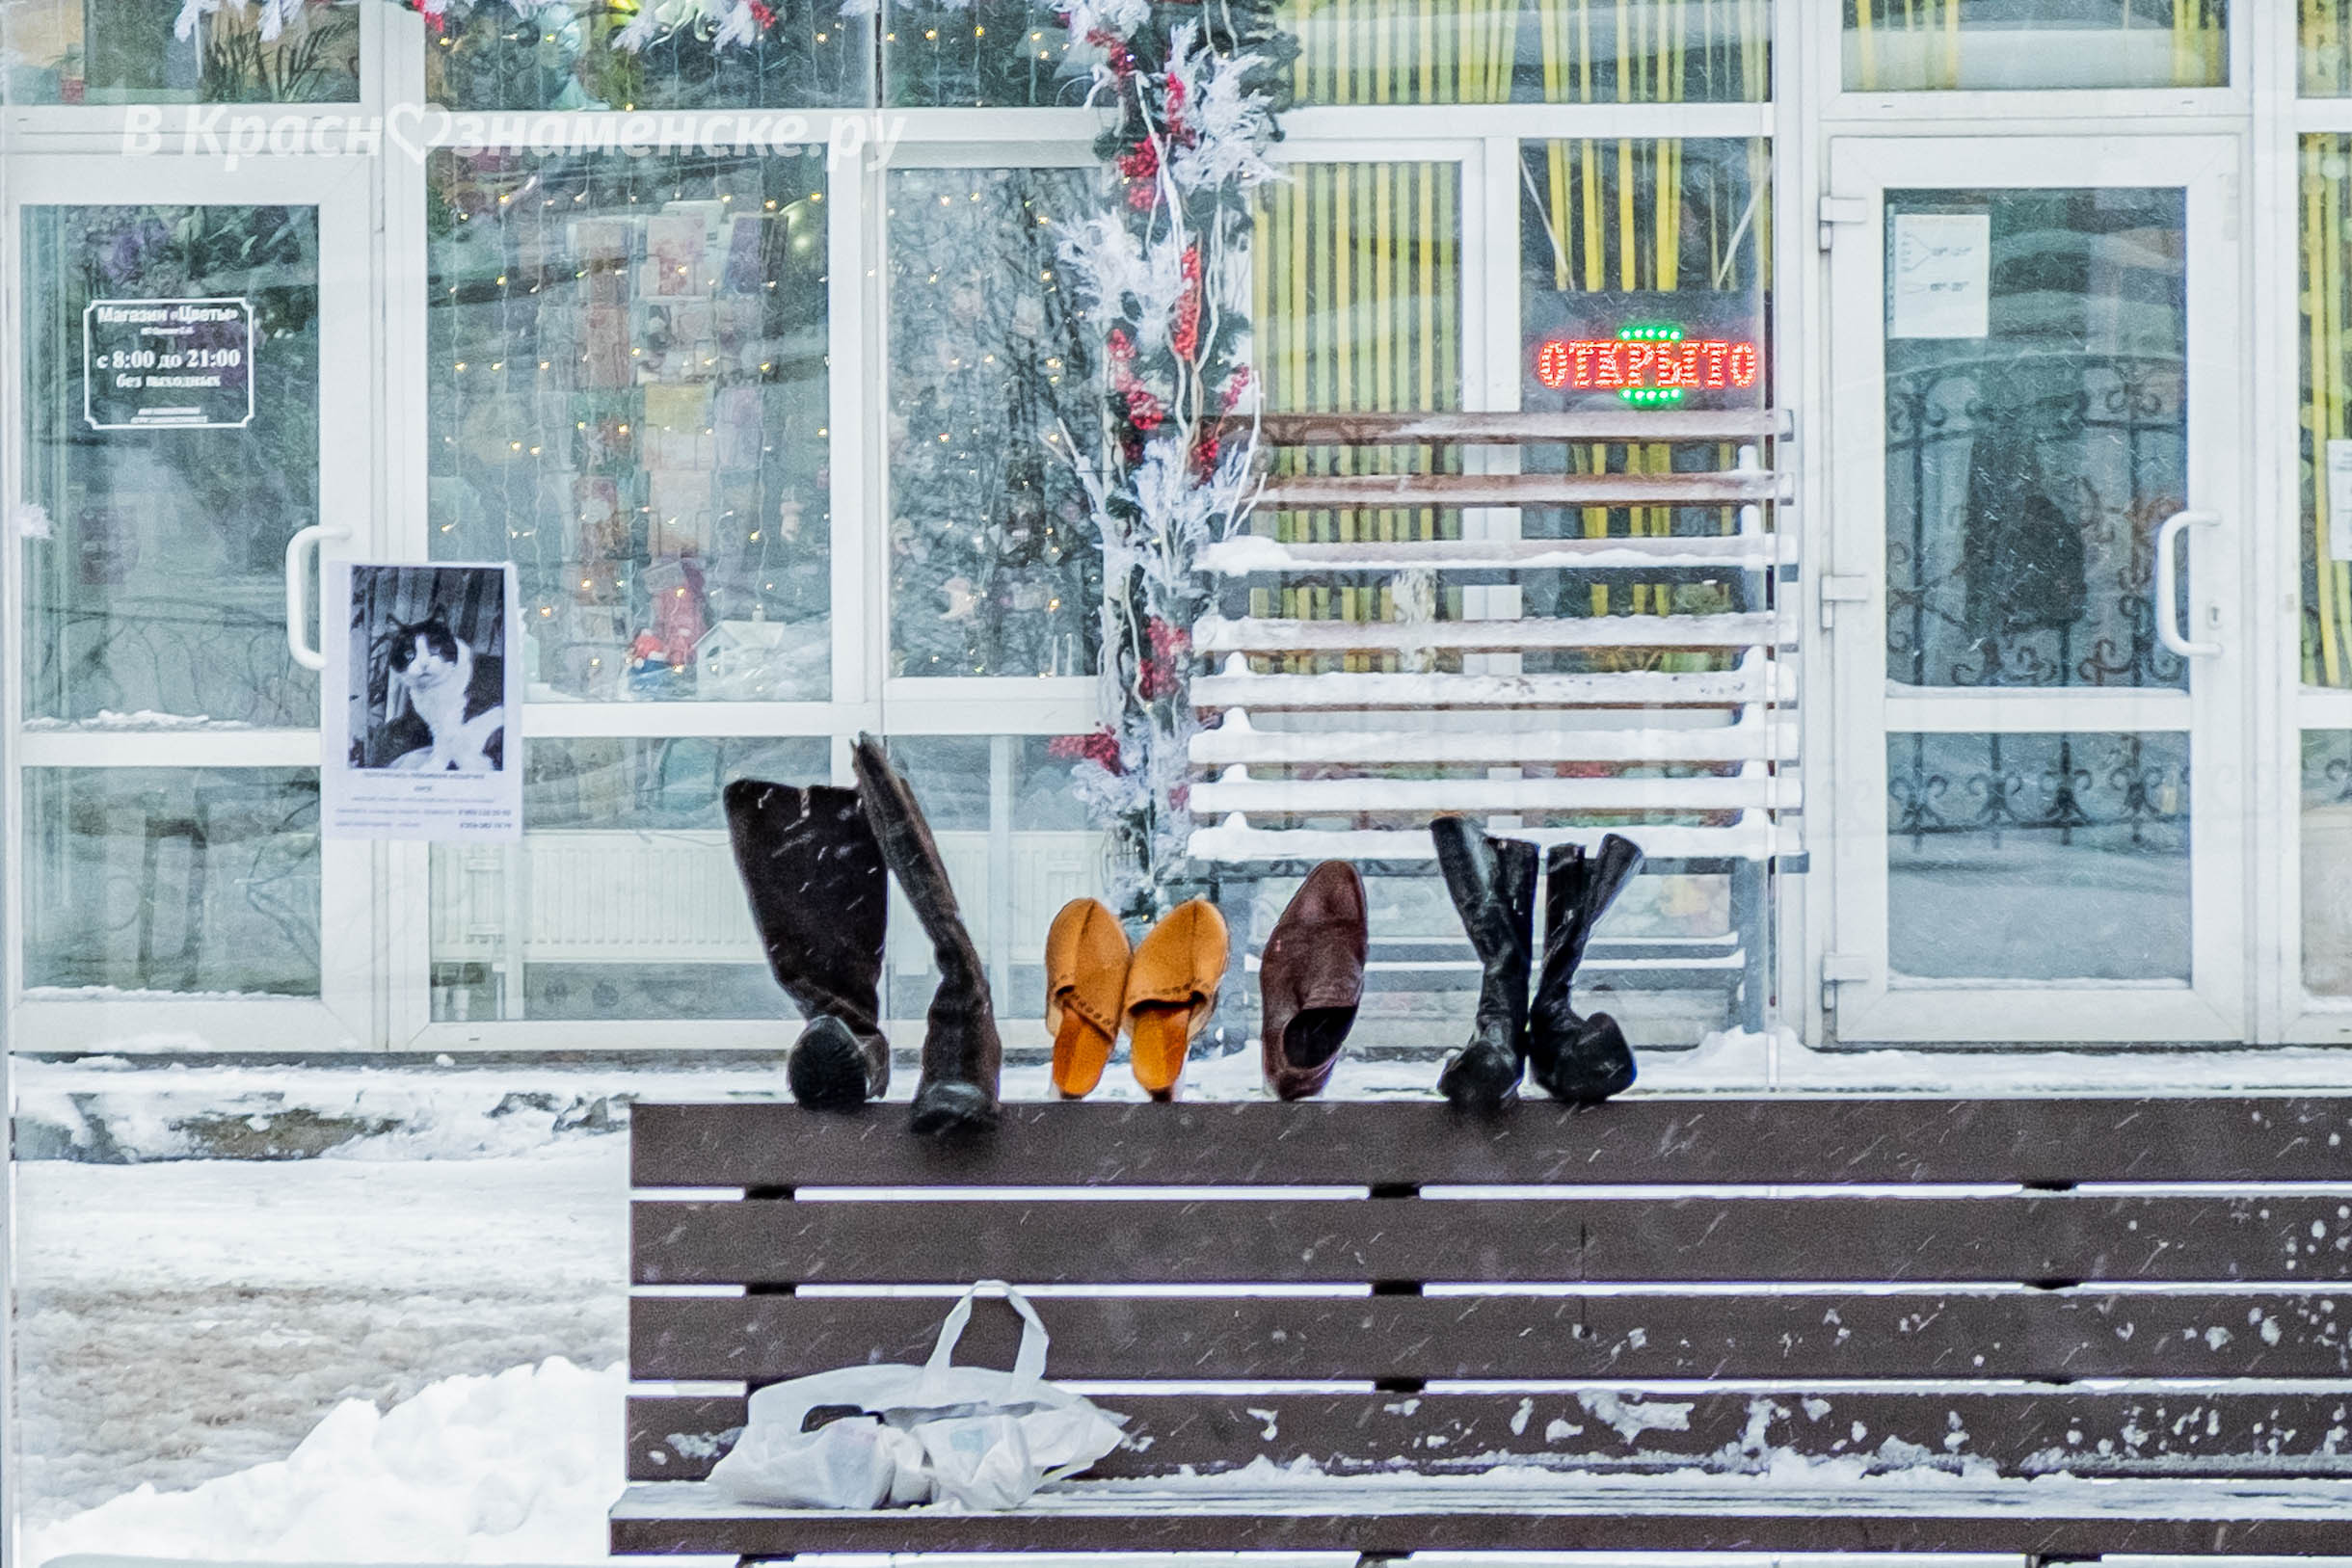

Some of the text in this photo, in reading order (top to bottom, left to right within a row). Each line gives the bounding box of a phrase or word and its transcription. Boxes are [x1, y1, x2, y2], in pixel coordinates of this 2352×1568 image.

[97, 306, 169, 324] Магазин
[96, 349, 241, 369] с 8:00 до 21:00
[1539, 339, 1756, 388] ОТКРЫТО
